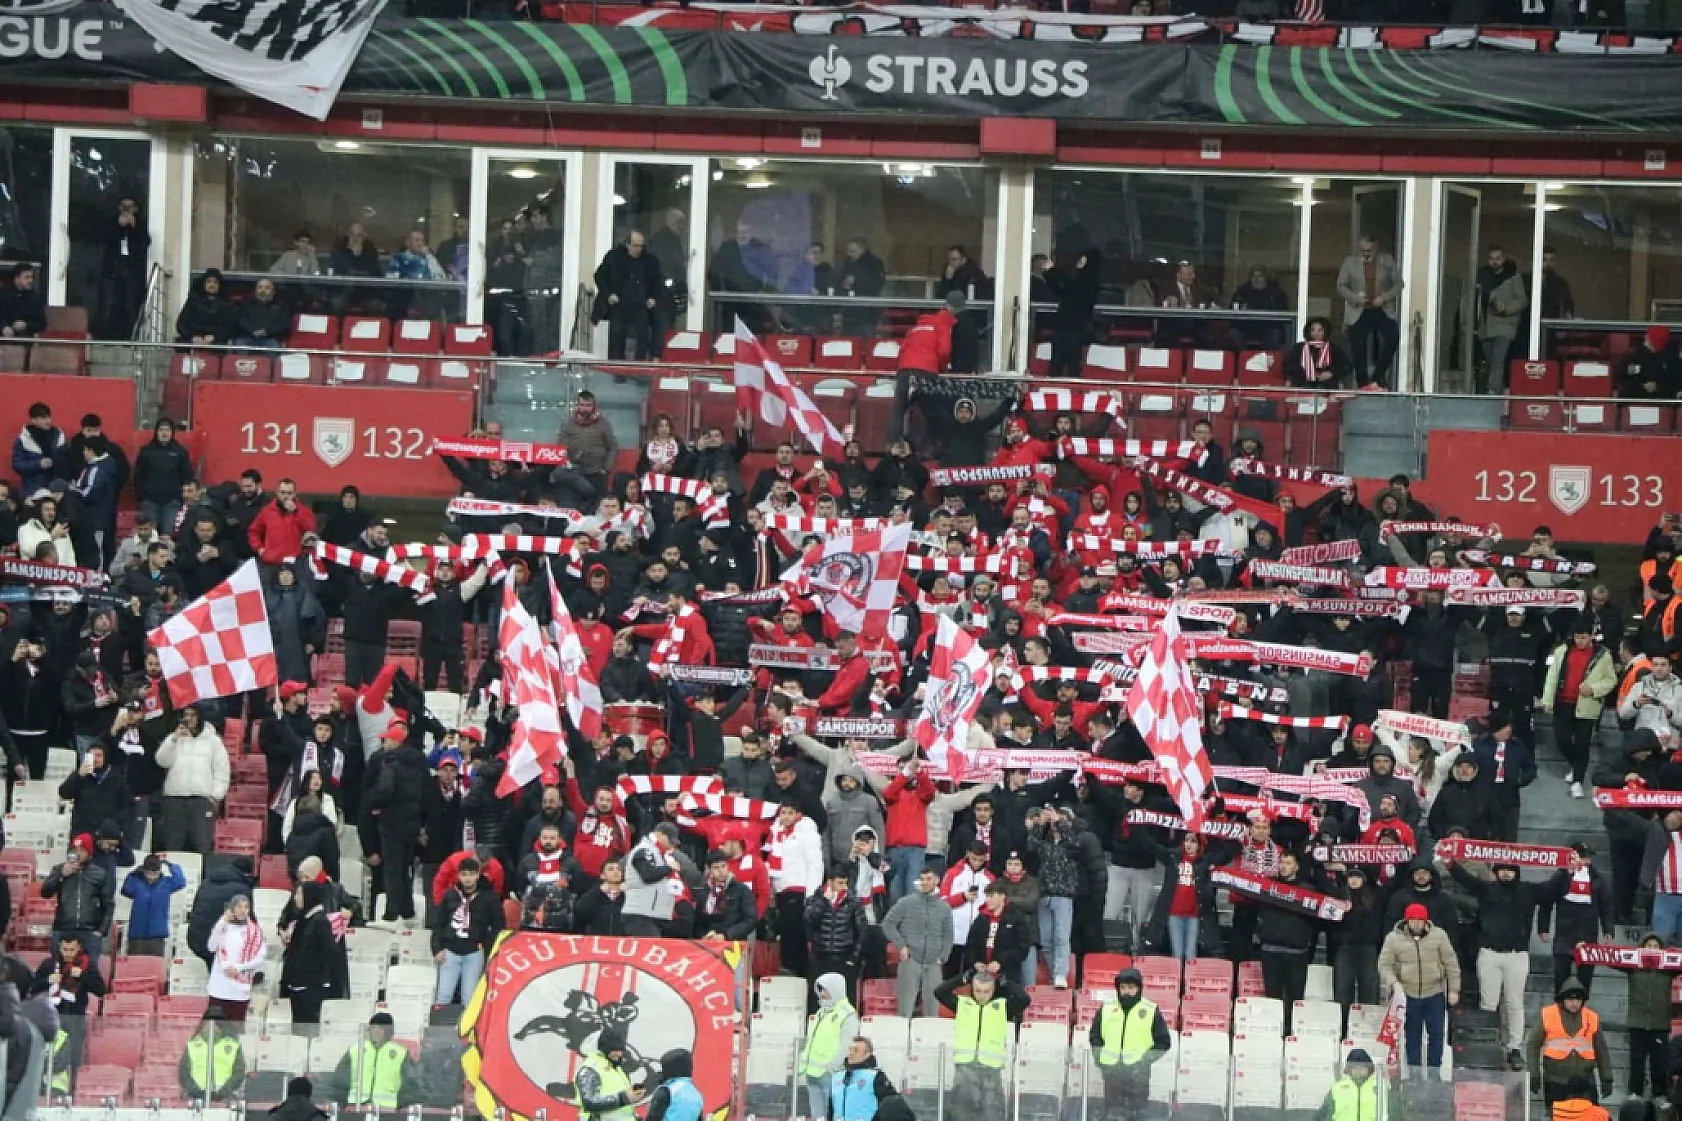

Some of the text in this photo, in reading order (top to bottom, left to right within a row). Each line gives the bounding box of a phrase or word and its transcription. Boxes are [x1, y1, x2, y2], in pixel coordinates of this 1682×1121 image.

[0, 17, 103, 60] GUE
[865, 54, 1090, 98] STRAUSS
[241, 422, 302, 454] 131
[363, 427, 425, 459] 132
[1475, 470, 1537, 502] 132
[1600, 474, 1664, 507] 133
[5, 560, 84, 584] SAMSUNSPOR
[1396, 571, 1480, 585] SAMSUNSPOR
[1105, 596, 1236, 619] SAMSUN SPOR
[1301, 600, 1383, 613] AMSUNSPOR
[1473, 589, 1556, 603] SAMSUNSPOR
[816, 721, 896, 735] SAMSUNSPOR
[1331, 849, 1409, 862] SAMSUNSPO
[1464, 844, 1556, 866] SAMSUNSPOR
